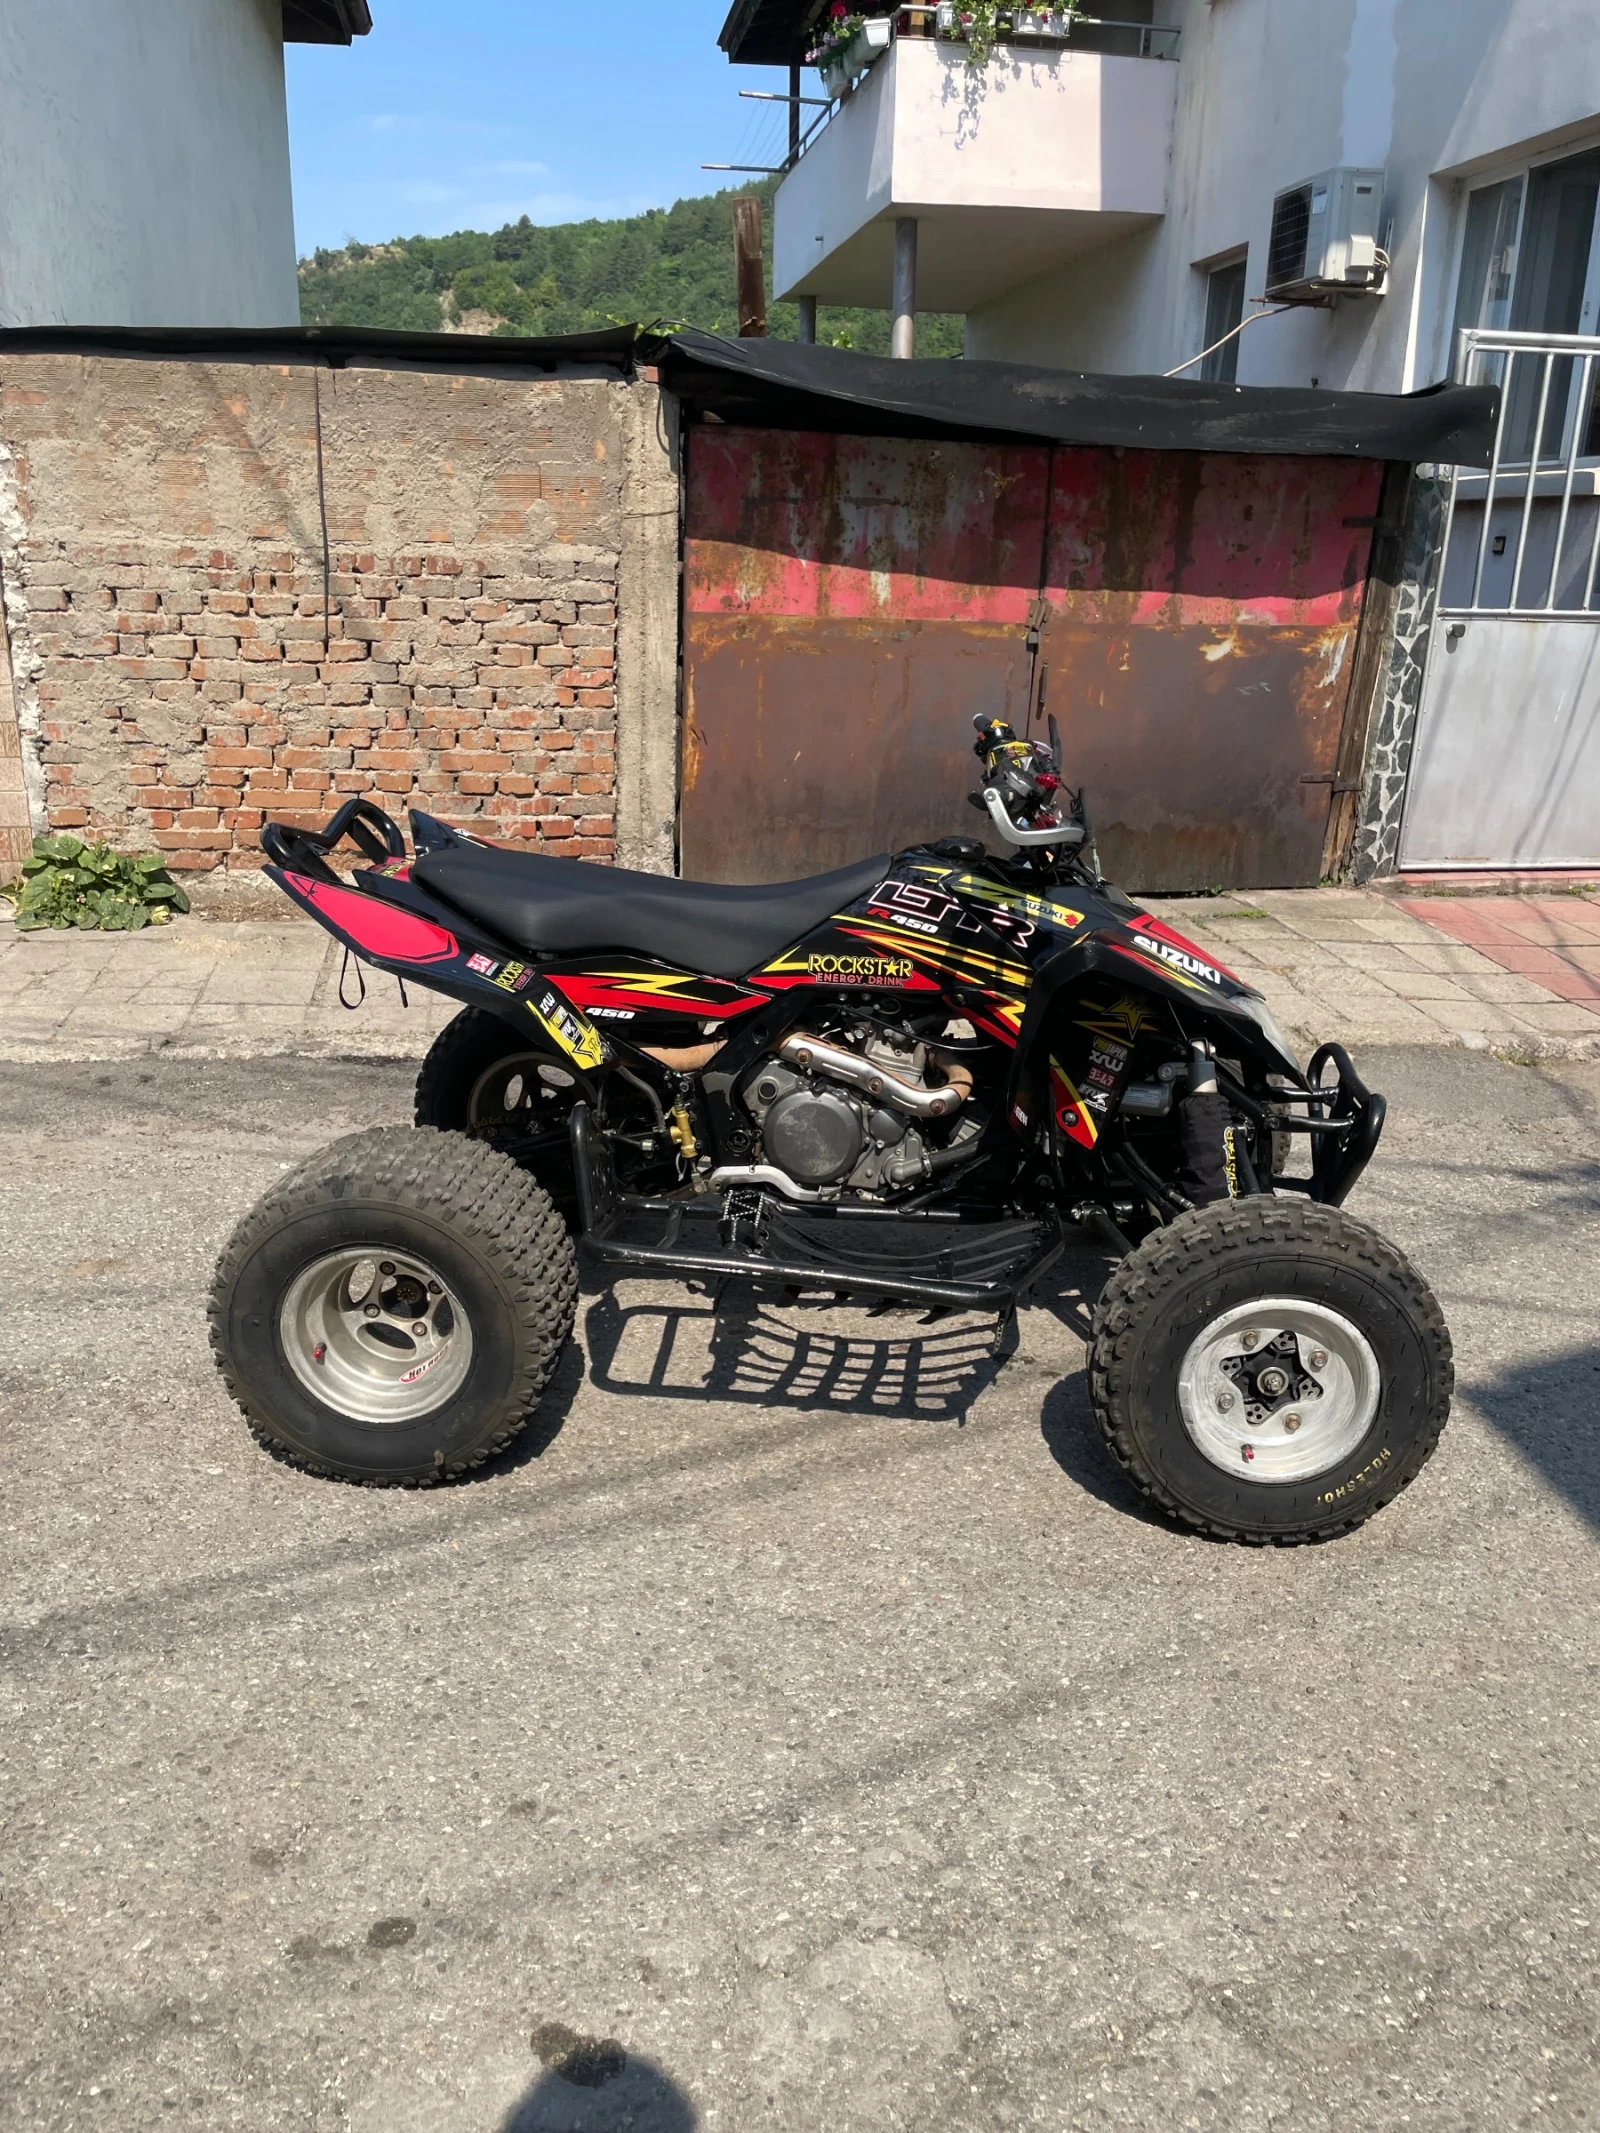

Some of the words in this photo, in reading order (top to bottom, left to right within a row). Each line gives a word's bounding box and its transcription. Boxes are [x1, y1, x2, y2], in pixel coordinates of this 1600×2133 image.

[1021, 899, 1064, 920] SUZUKI
[808, 954, 914, 977] ROCKSTAR
[1133, 935, 1221, 985] SUZUKI
[816, 973, 863, 984] ENERGY
[868, 975, 903, 987] DRINK
[585, 1007, 636, 1019] 450
